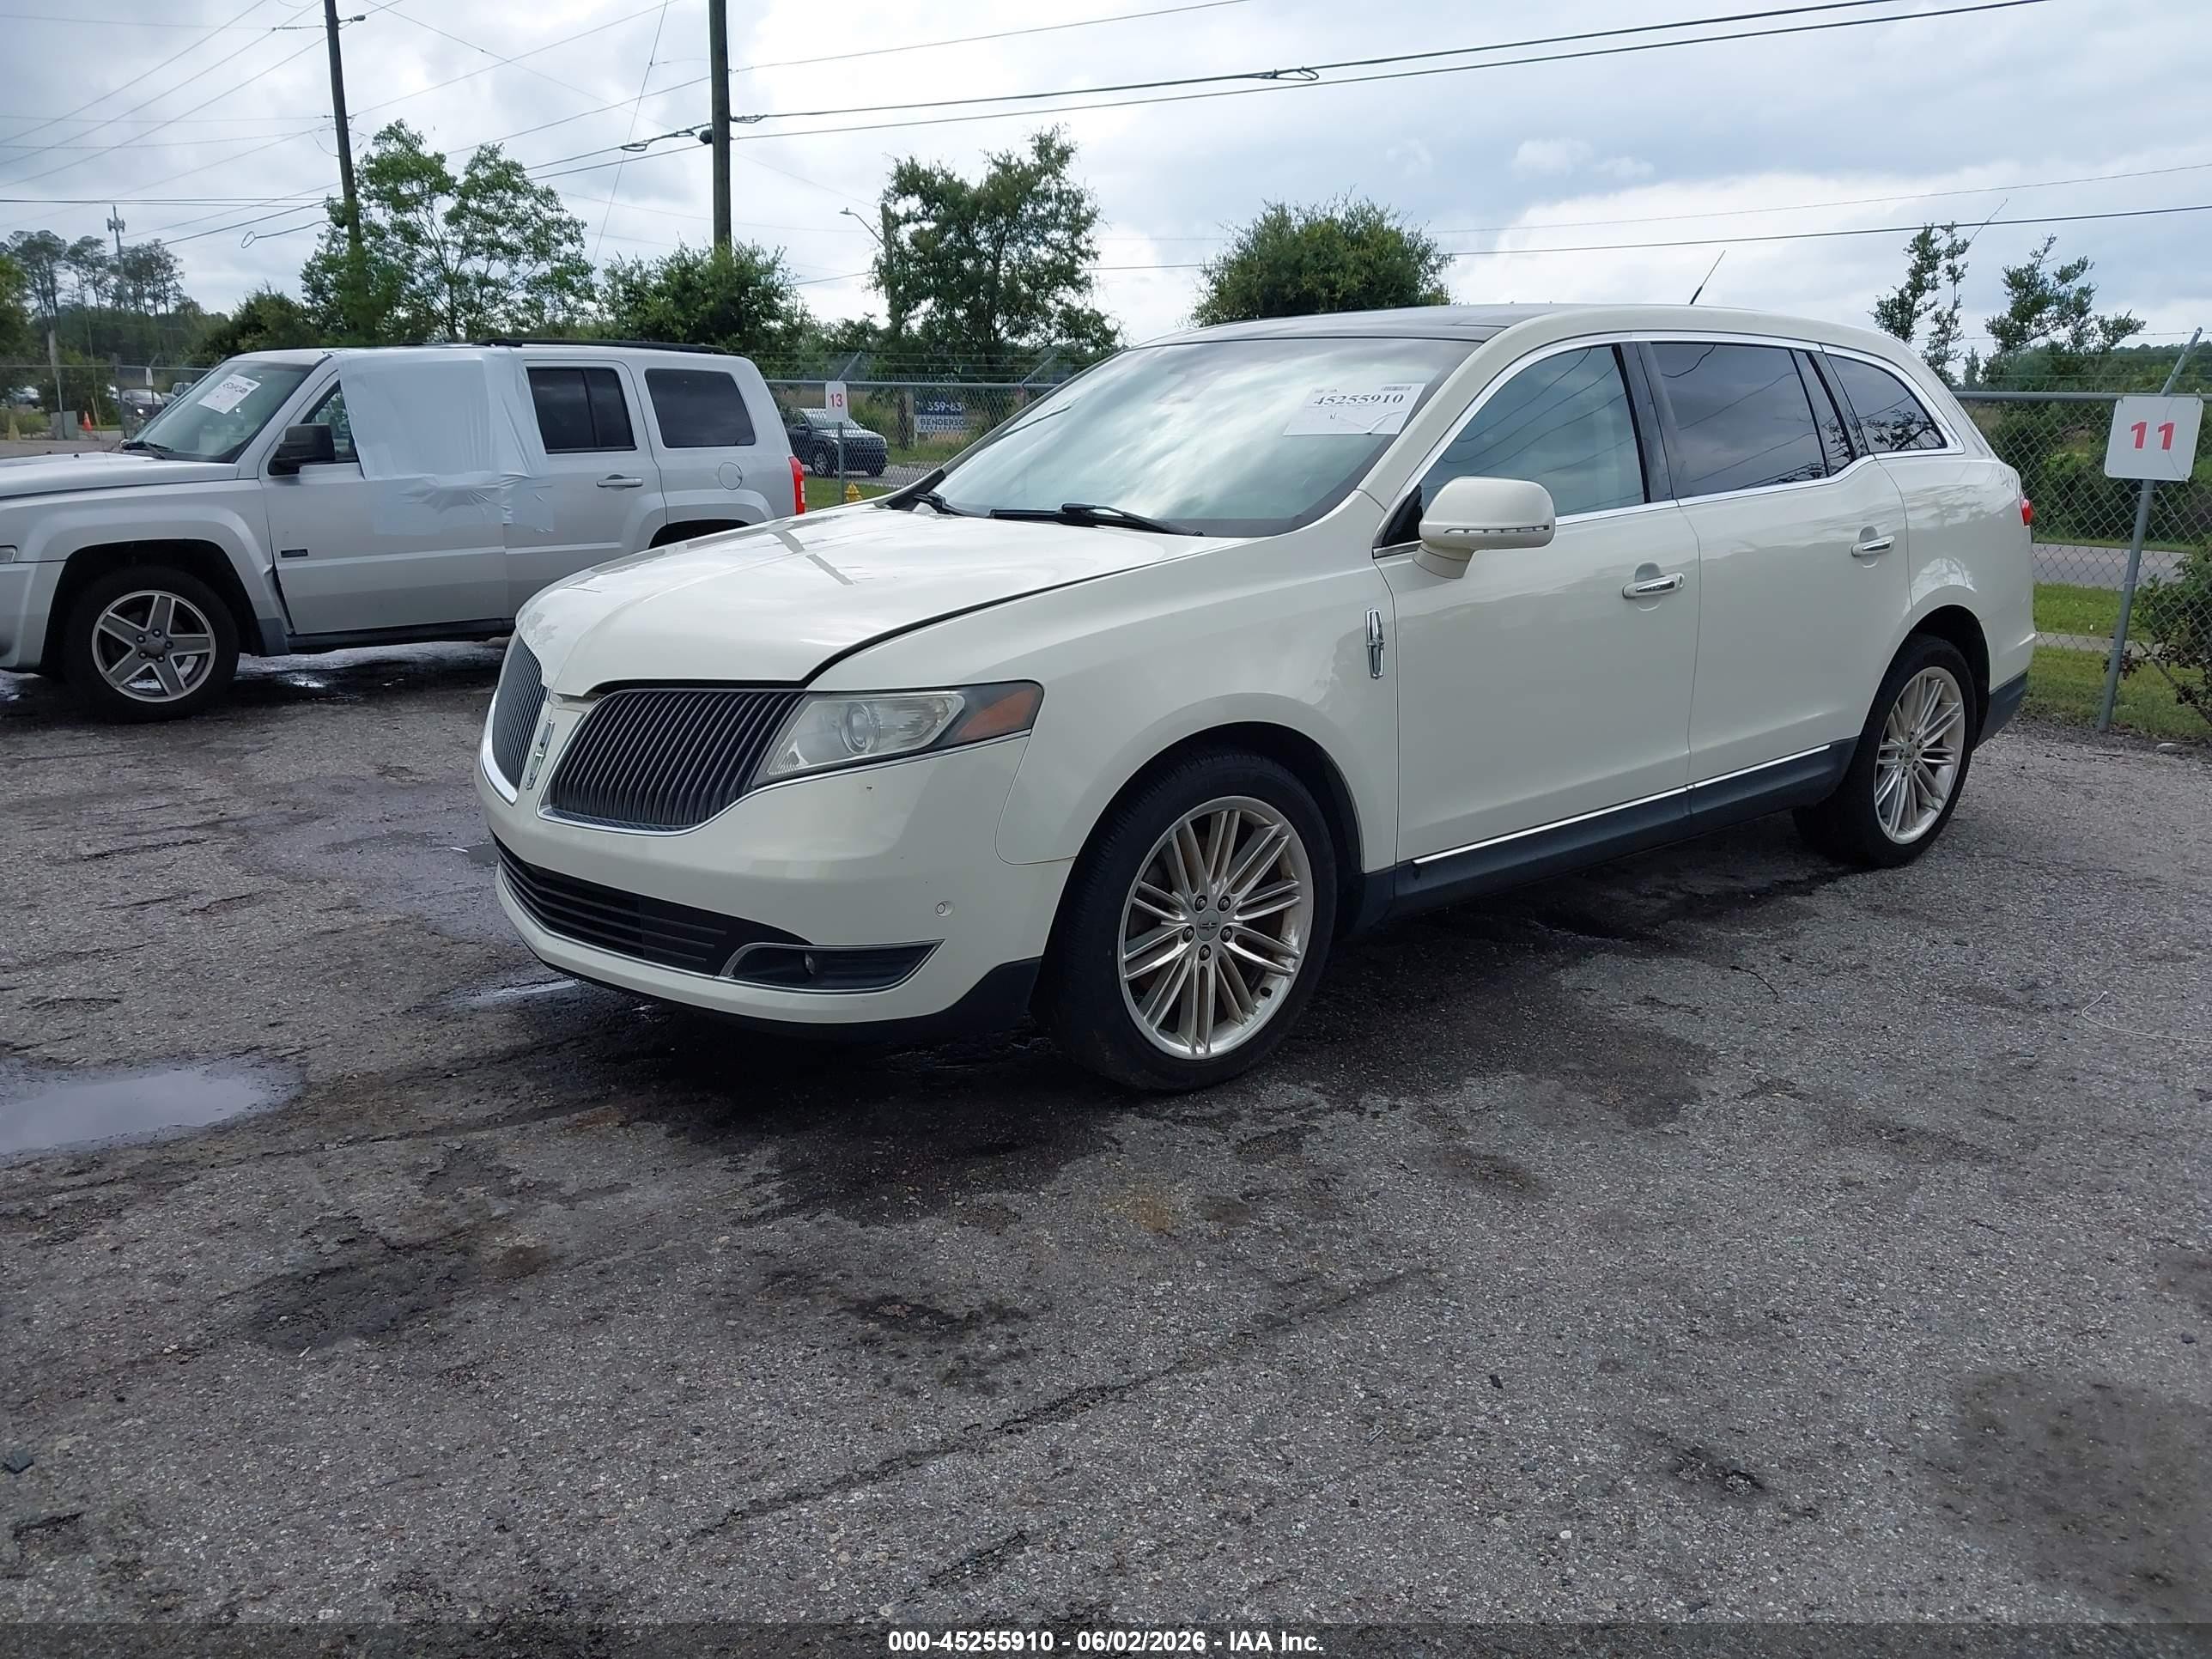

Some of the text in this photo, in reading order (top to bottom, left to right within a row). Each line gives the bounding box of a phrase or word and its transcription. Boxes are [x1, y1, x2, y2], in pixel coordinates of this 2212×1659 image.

[830, 393, 843, 407] 13
[1314, 394, 1404, 405] 45255910
[2130, 421, 2175, 451] 11
